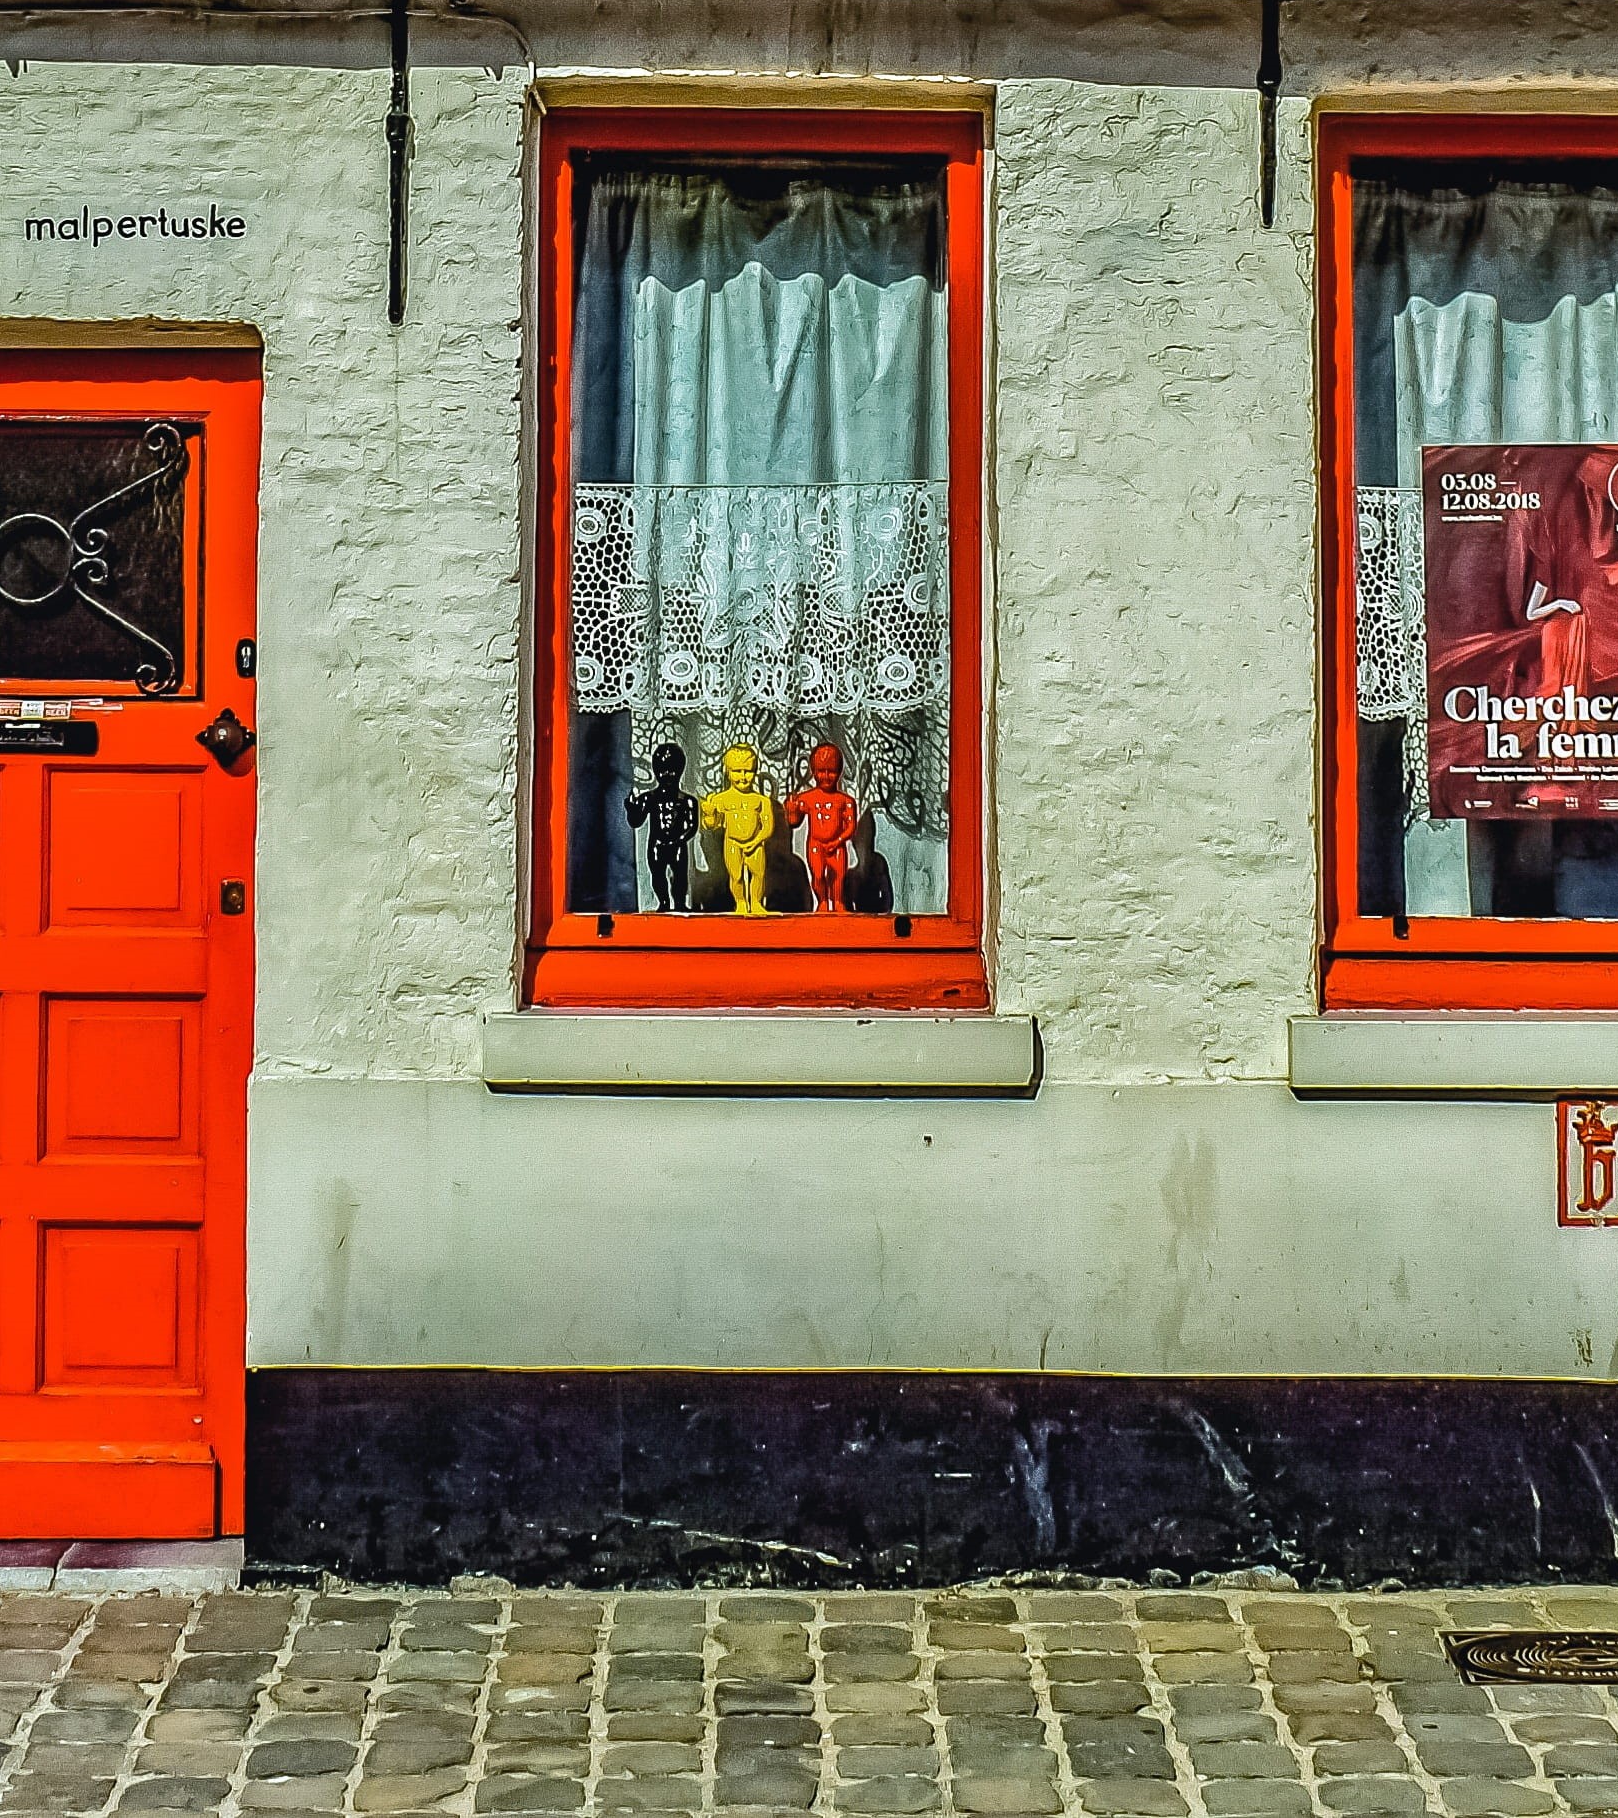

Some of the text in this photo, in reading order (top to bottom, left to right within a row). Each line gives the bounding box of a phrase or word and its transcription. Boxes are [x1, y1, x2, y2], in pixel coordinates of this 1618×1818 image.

[25, 203, 247, 247] malpertuske
[1442, 492, 1541, 510] 12.08.2018
[1485, 722, 1522, 759] la
